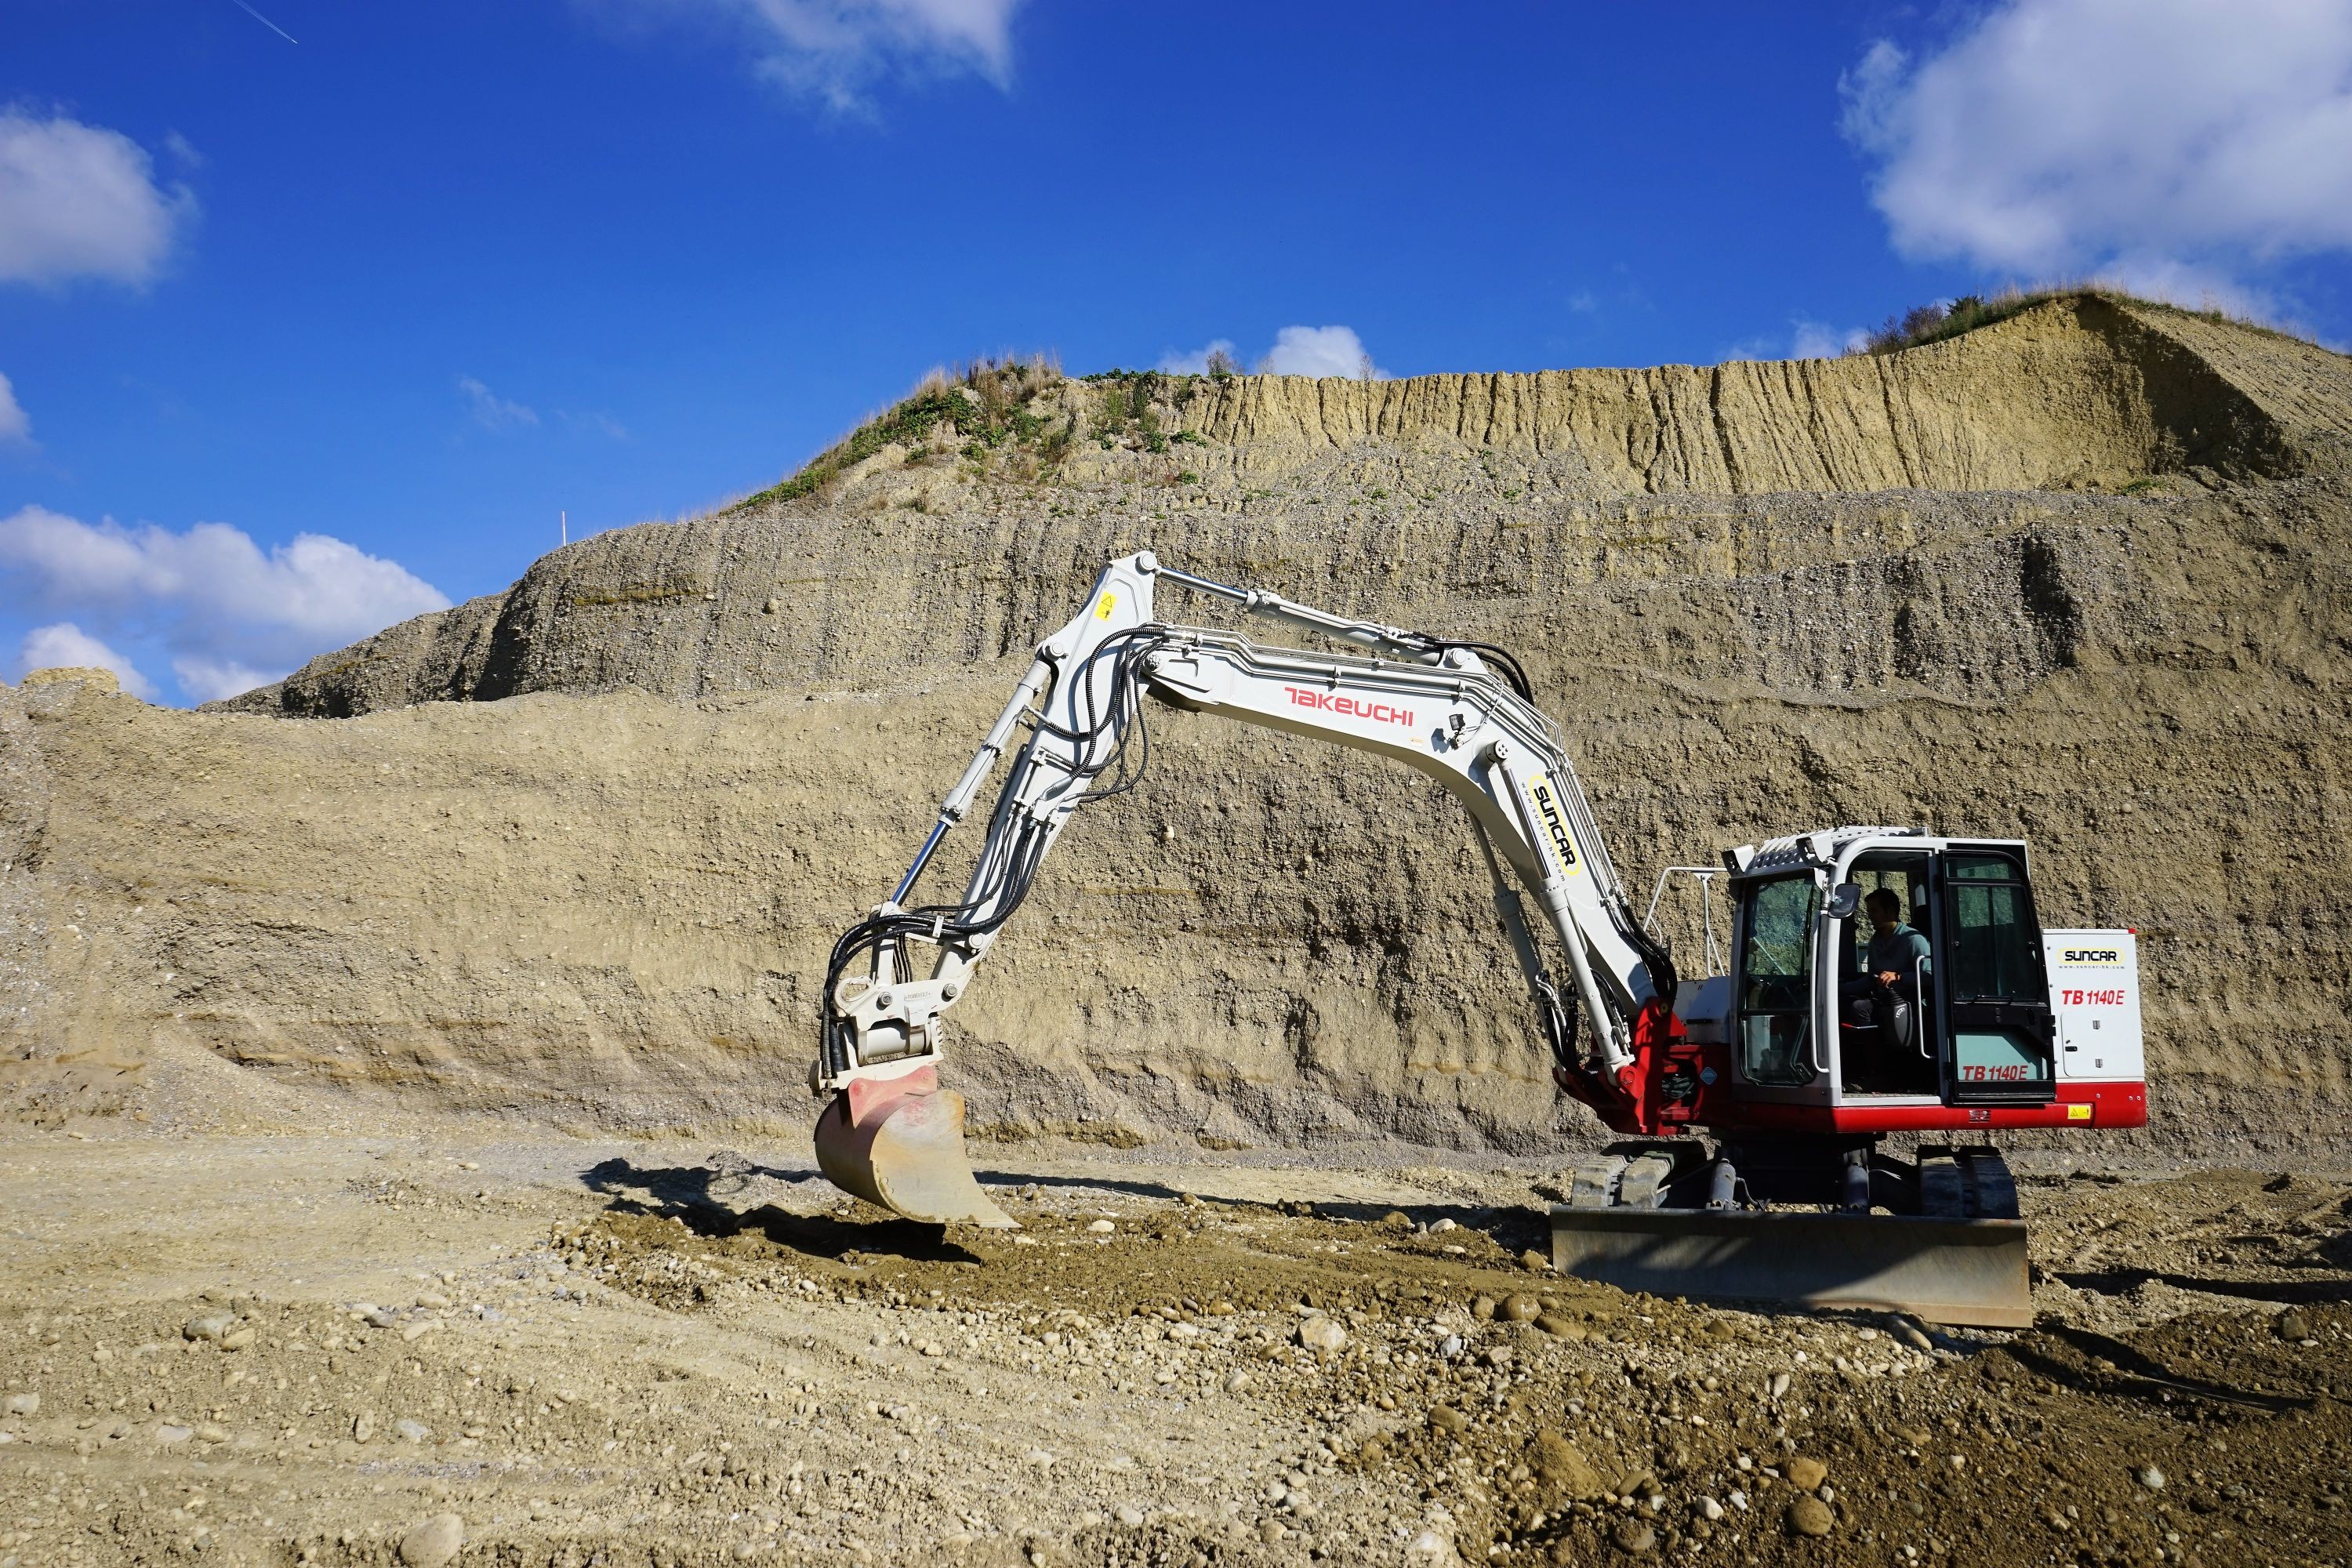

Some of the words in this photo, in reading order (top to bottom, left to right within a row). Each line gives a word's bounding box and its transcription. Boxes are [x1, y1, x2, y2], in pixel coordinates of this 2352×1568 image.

[1521, 782, 1566, 882] www.suncar-hk.com
[1534, 786, 1576, 866] SUNCAR
[2064, 950, 2117, 962] SUNCAR
